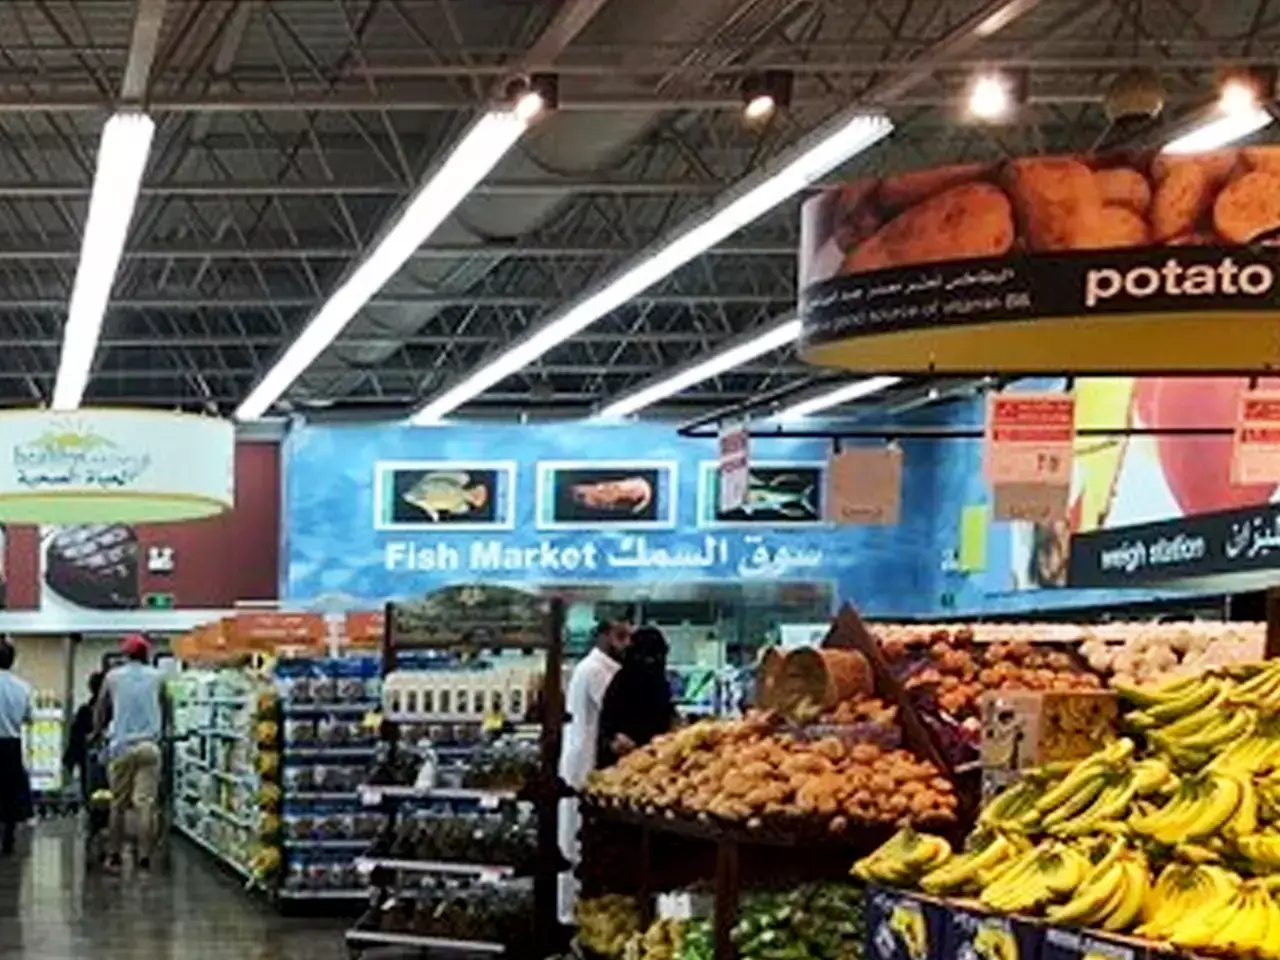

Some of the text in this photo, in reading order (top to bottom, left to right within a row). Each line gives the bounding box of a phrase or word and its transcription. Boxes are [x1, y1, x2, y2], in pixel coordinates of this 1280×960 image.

[1085, 257, 1273, 307] potato
[385, 541, 597, 570] Fish Market
[607, 534, 823, 579] سوق السمك
